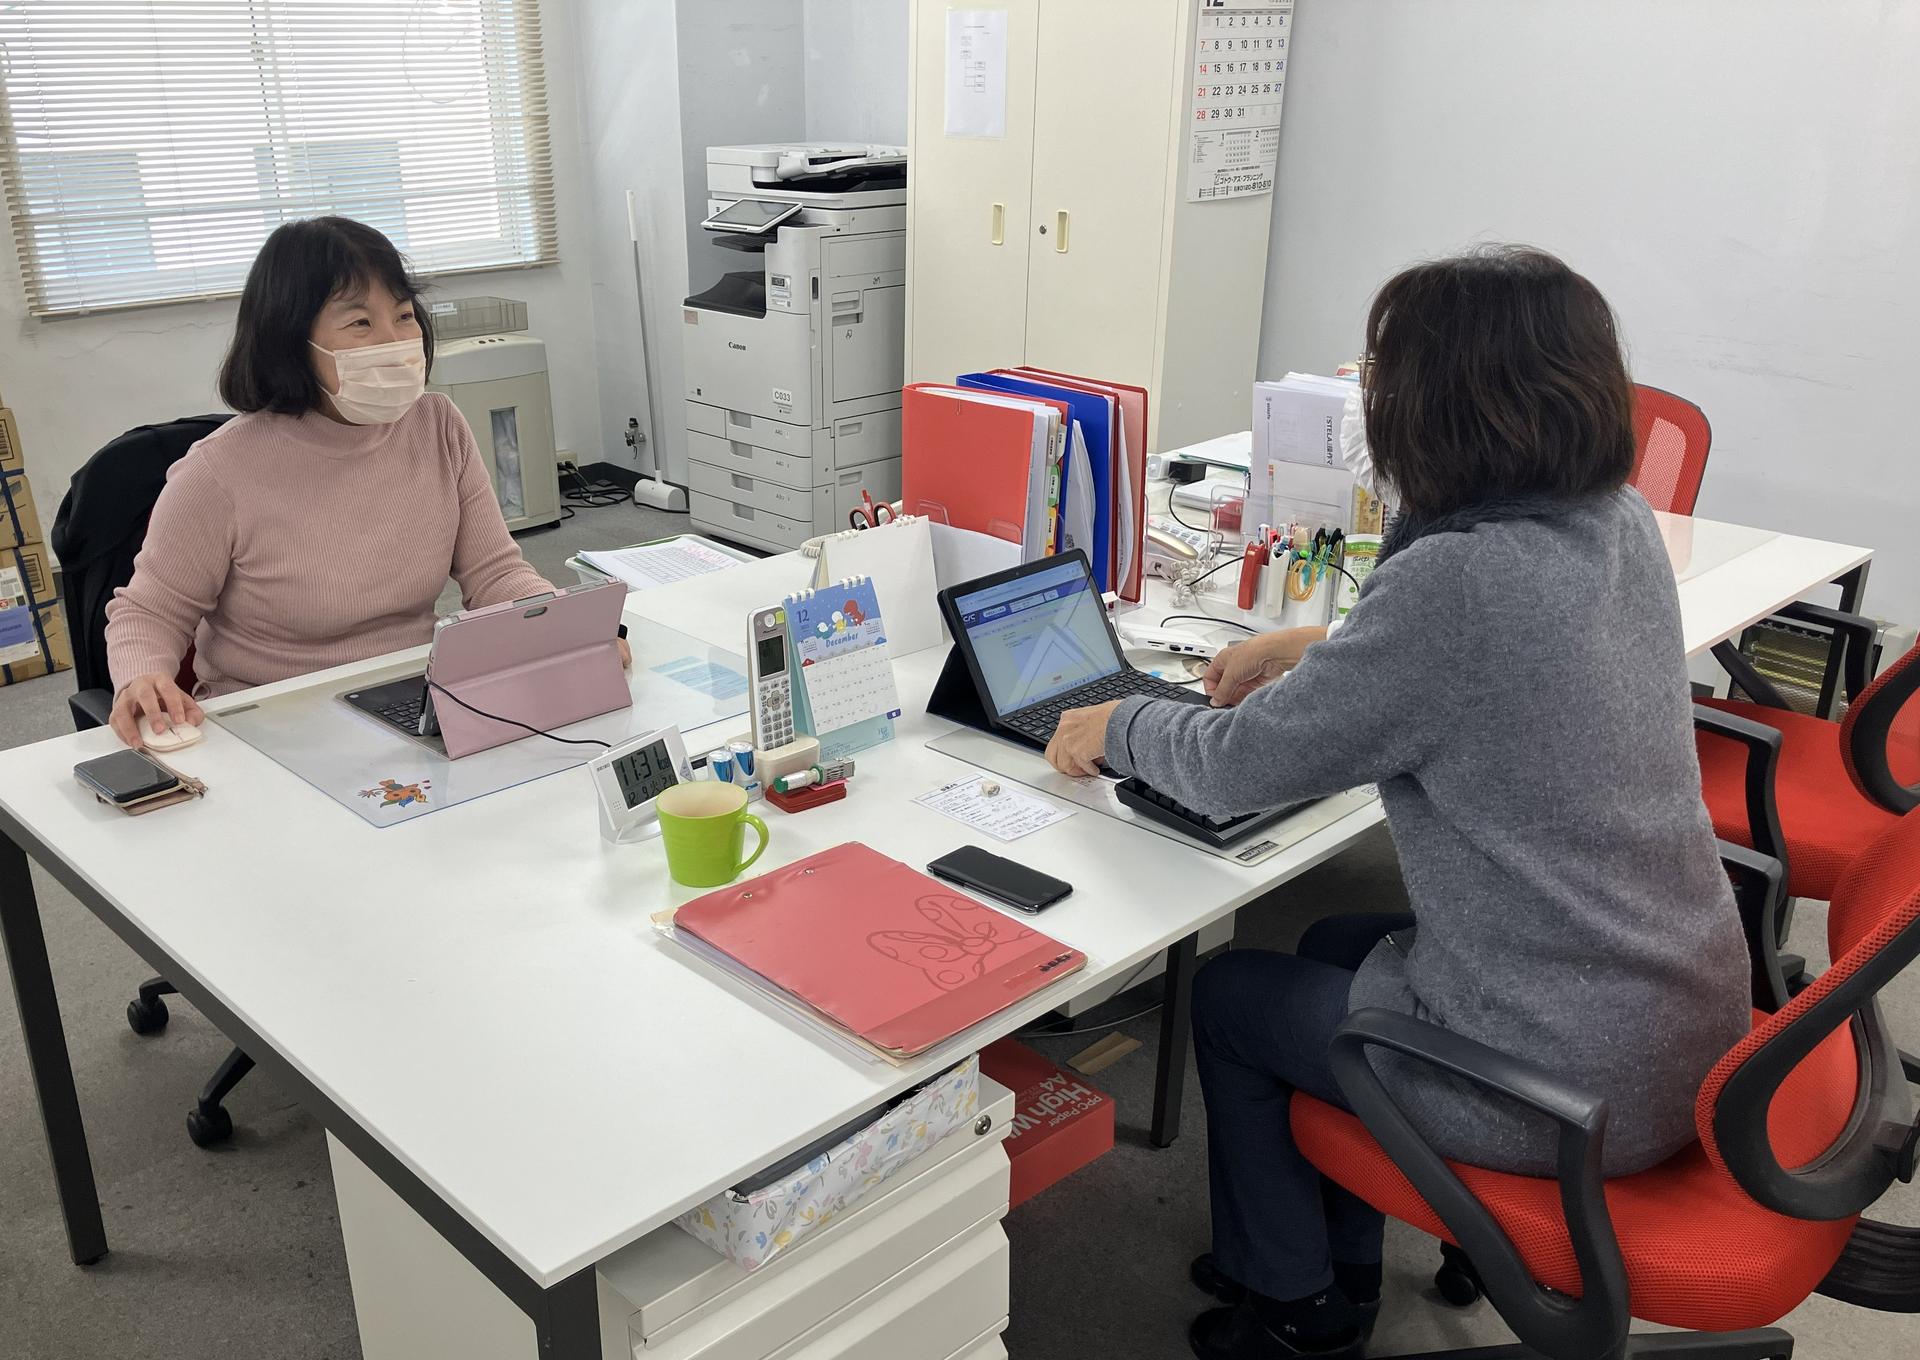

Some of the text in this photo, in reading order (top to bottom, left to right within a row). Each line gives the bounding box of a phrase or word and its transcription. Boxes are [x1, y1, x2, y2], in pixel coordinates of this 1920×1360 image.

[1241, 40, 1247, 49] 10
[1253, 40, 1260, 48] 11
[1266, 39, 1272, 48] 12
[1278, 39, 1284, 48] 13
[1199, 61, 1284, 73] 14 15 16 17 18 19 20
[1198, 83, 1282, 97] 21 22 23 24 25 26 27
[1197, 107, 1245, 119] 28 29 30 31
[728, 341, 746, 351] Canon
[774, 390, 791, 402] C033
[796, 609, 810, 624] 12
[826, 632, 858, 648] December
[620, 745, 662, 787] 11:31
[1038, 1072, 1067, 1092] A4
[1027, 1082, 1091, 1116] High
[1048, 1095, 1102, 1127] PPC Paper
[1009, 1113, 1041, 1139] W
